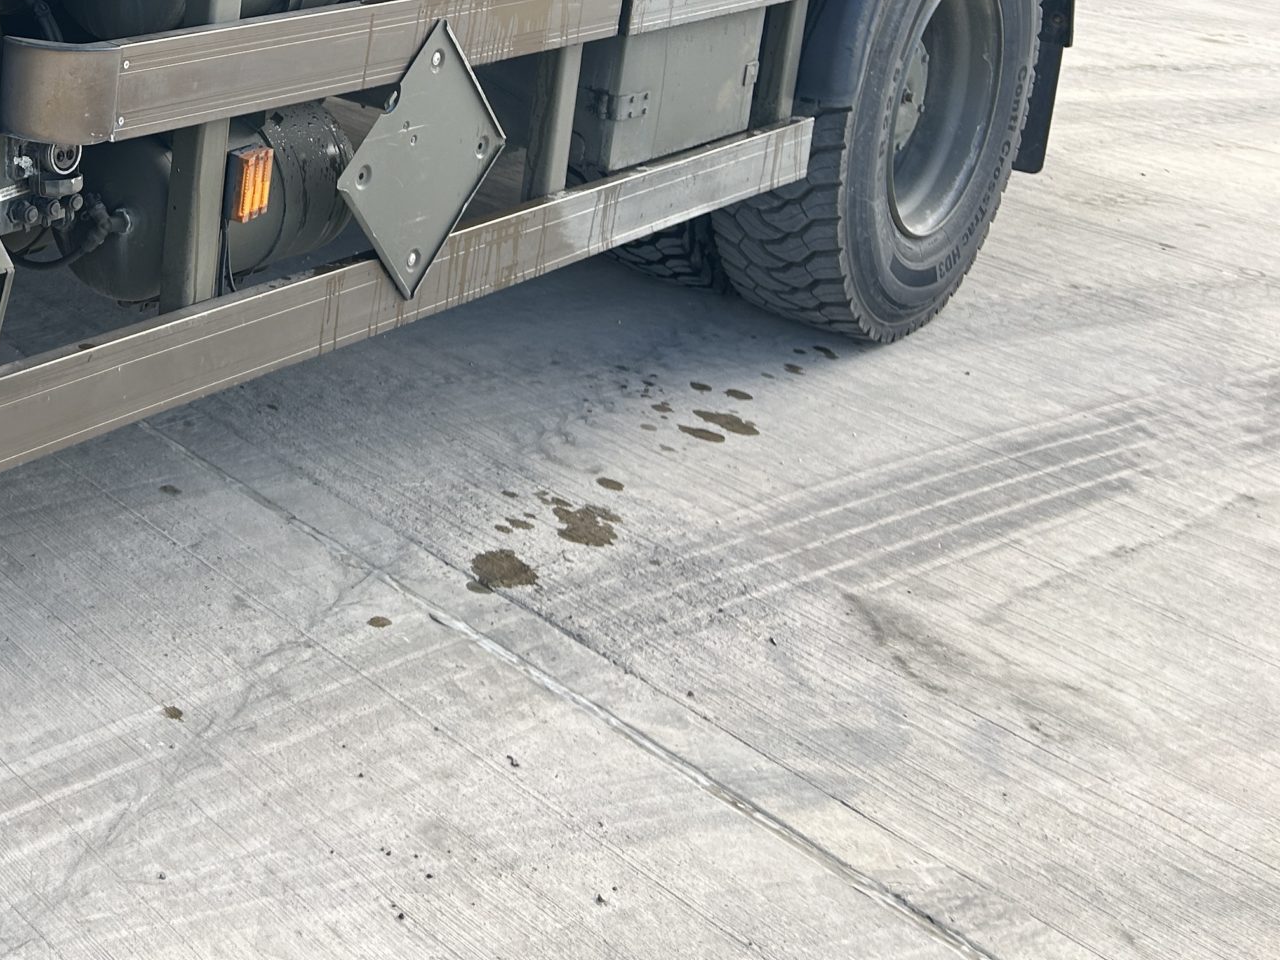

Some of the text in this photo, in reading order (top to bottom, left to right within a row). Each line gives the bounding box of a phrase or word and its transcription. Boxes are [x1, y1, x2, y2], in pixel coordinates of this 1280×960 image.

[938, 65, 1028, 279] Conti CrossTrac HD3
